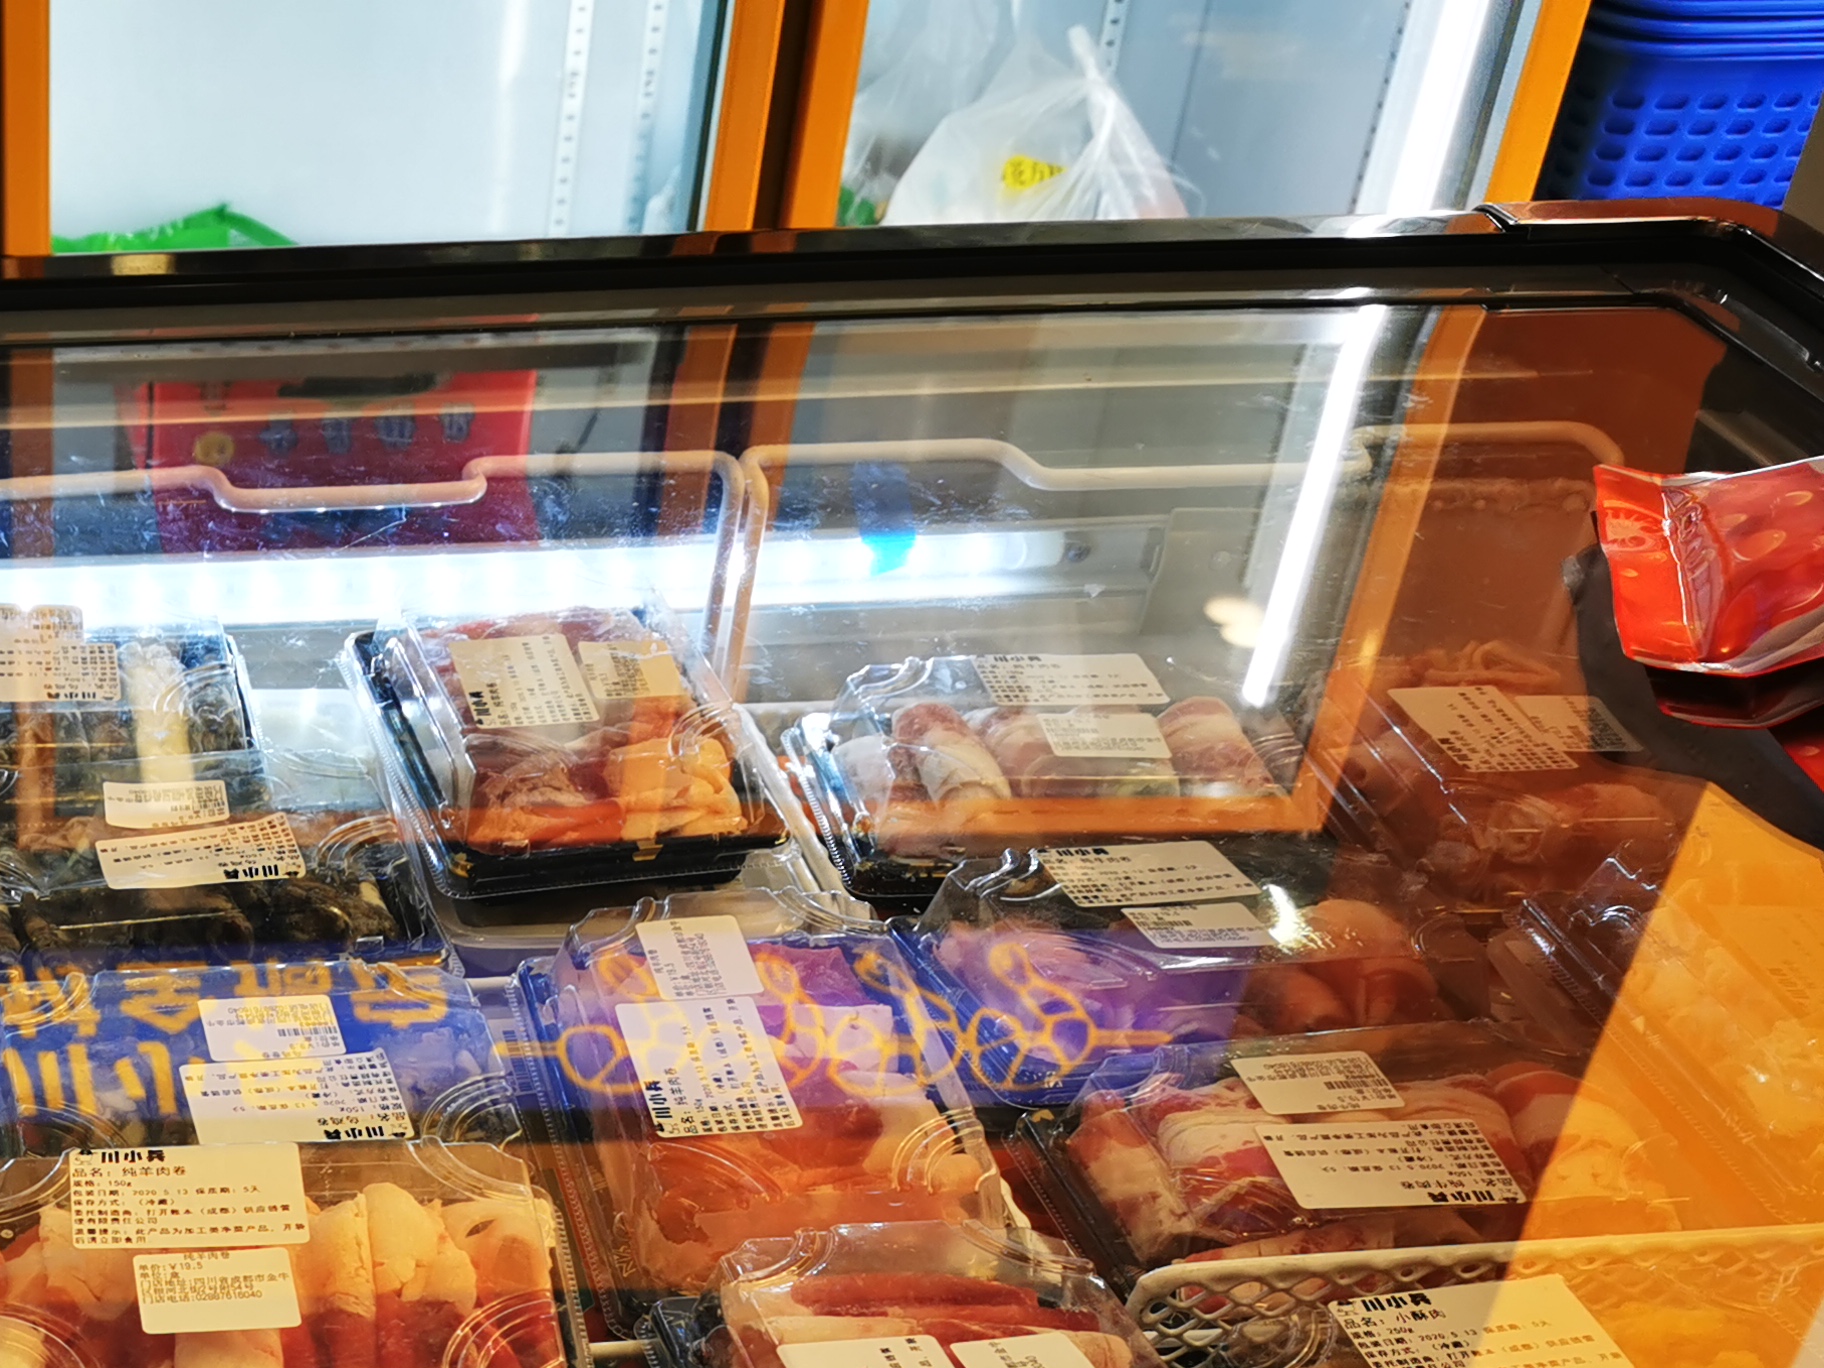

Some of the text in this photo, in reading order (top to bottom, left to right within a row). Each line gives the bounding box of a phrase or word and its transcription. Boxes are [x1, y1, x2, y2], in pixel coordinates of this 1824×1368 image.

[644, 1080, 673, 1119] 川小兵
[324, 1126, 384, 1140] 川小兵
[101, 1150, 166, 1163] 川小兵
[72, 1166, 186, 1177] 品名：纯羊肉卷
[1427, 1190, 1495, 1203] 川小兵
[1360, 1292, 1433, 1312] 川小兵
[1342, 1309, 1447, 1330] 品名：小酥肉
